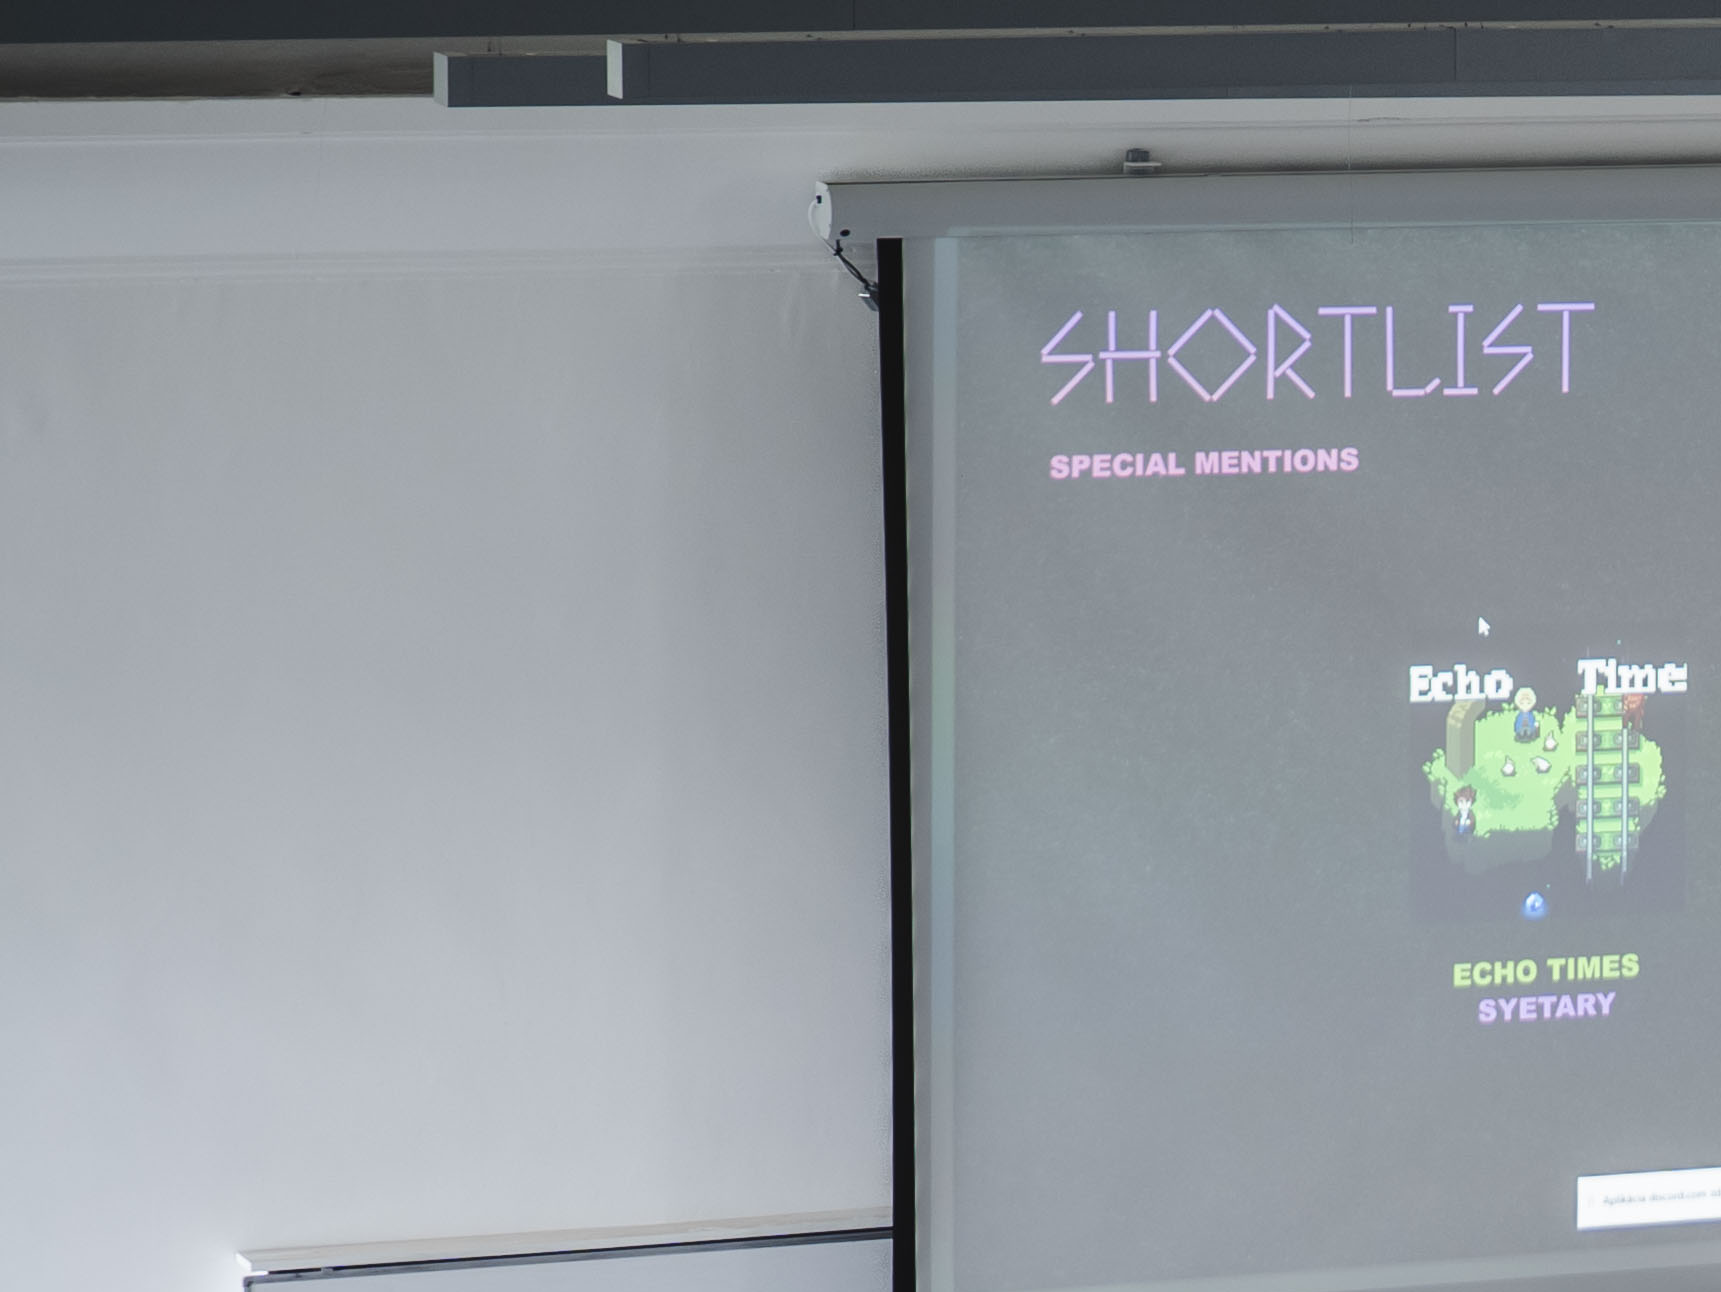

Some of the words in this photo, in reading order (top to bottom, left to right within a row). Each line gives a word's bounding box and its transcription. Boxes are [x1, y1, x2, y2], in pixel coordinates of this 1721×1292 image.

[1041, 303, 1596, 404] SHORTLIST
[1050, 452, 1185, 478] SPECIAL
[1195, 447, 1359, 474] MENTIONS
[1410, 664, 1513, 702] Echo
[1577, 659, 1688, 695] Time
[1453, 959, 1538, 988] ECHO
[1547, 953, 1640, 982] TIMES
[1478, 992, 1616, 1023] SYETARY
